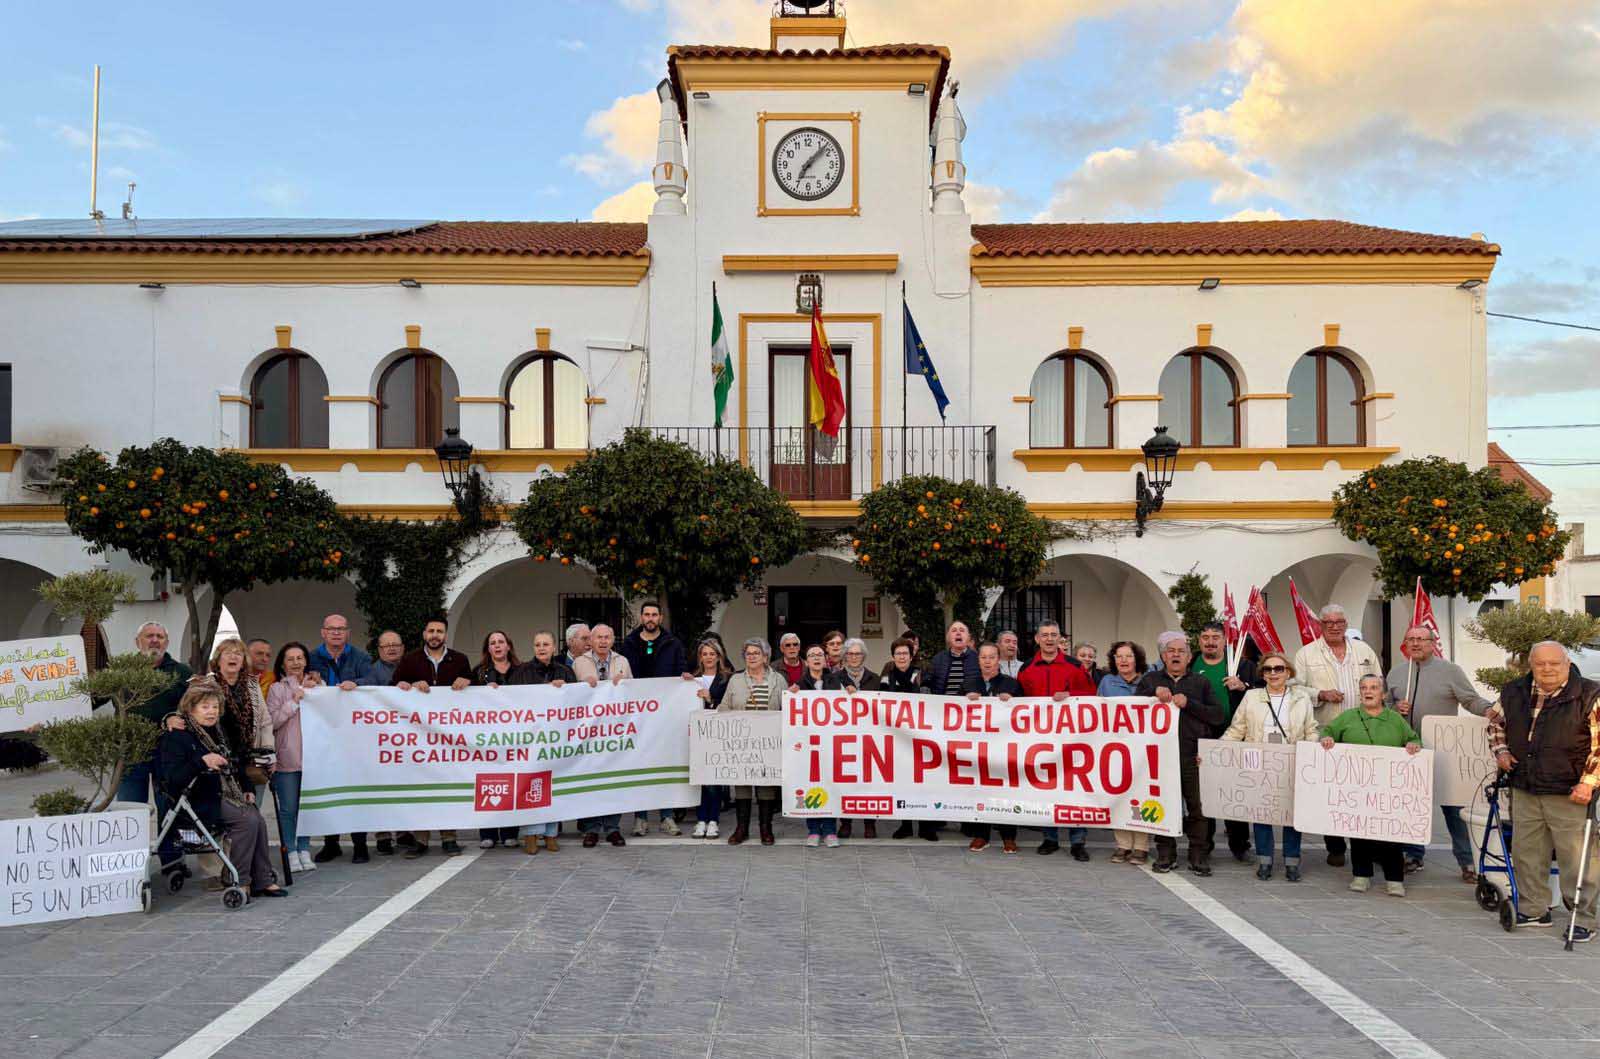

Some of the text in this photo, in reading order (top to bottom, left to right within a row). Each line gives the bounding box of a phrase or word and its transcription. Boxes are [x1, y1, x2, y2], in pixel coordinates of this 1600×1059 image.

[794, 142, 800, 150] 11
[804, 138, 812, 147] 12
[786, 150, 794, 158] 10
[825, 149, 831, 157] 2
[782, 161, 788, 169] 9
[829, 160, 834, 169] 3
[786, 172, 792, 180] 8
[816, 180, 822, 188] 5
[825, 172, 830, 180] 4
[796, 180, 800, 189] 7
[805, 183, 811, 191] 6
[21, 656, 79, 681] VENDE
[352, 700, 659, 725] PSOE-A PEÑARROYA-PUEBLONUEVO
[789, 697, 1172, 735] HOSPITAL DEL GUADIATO
[378, 721, 637, 746] POR UNA SANIDAD PÚBLICA
[1434, 724, 1465, 756] POR
[379, 736, 635, 764] DE CALIDAD EN ANDALUCÍA
[809, 734, 1161, 797] ¡EN PELIGRO!
[481, 784, 509, 795] PSOE
[1219, 786, 1280, 807] NO SE
[1327, 786, 1430, 816] LAS MEJORAS
[16, 816, 139, 854] LA SANIDAD
[6, 852, 146, 885] NO ES UN NEGOCIO
[12, 891, 33, 915] ES
[43, 887, 71, 912] UN
